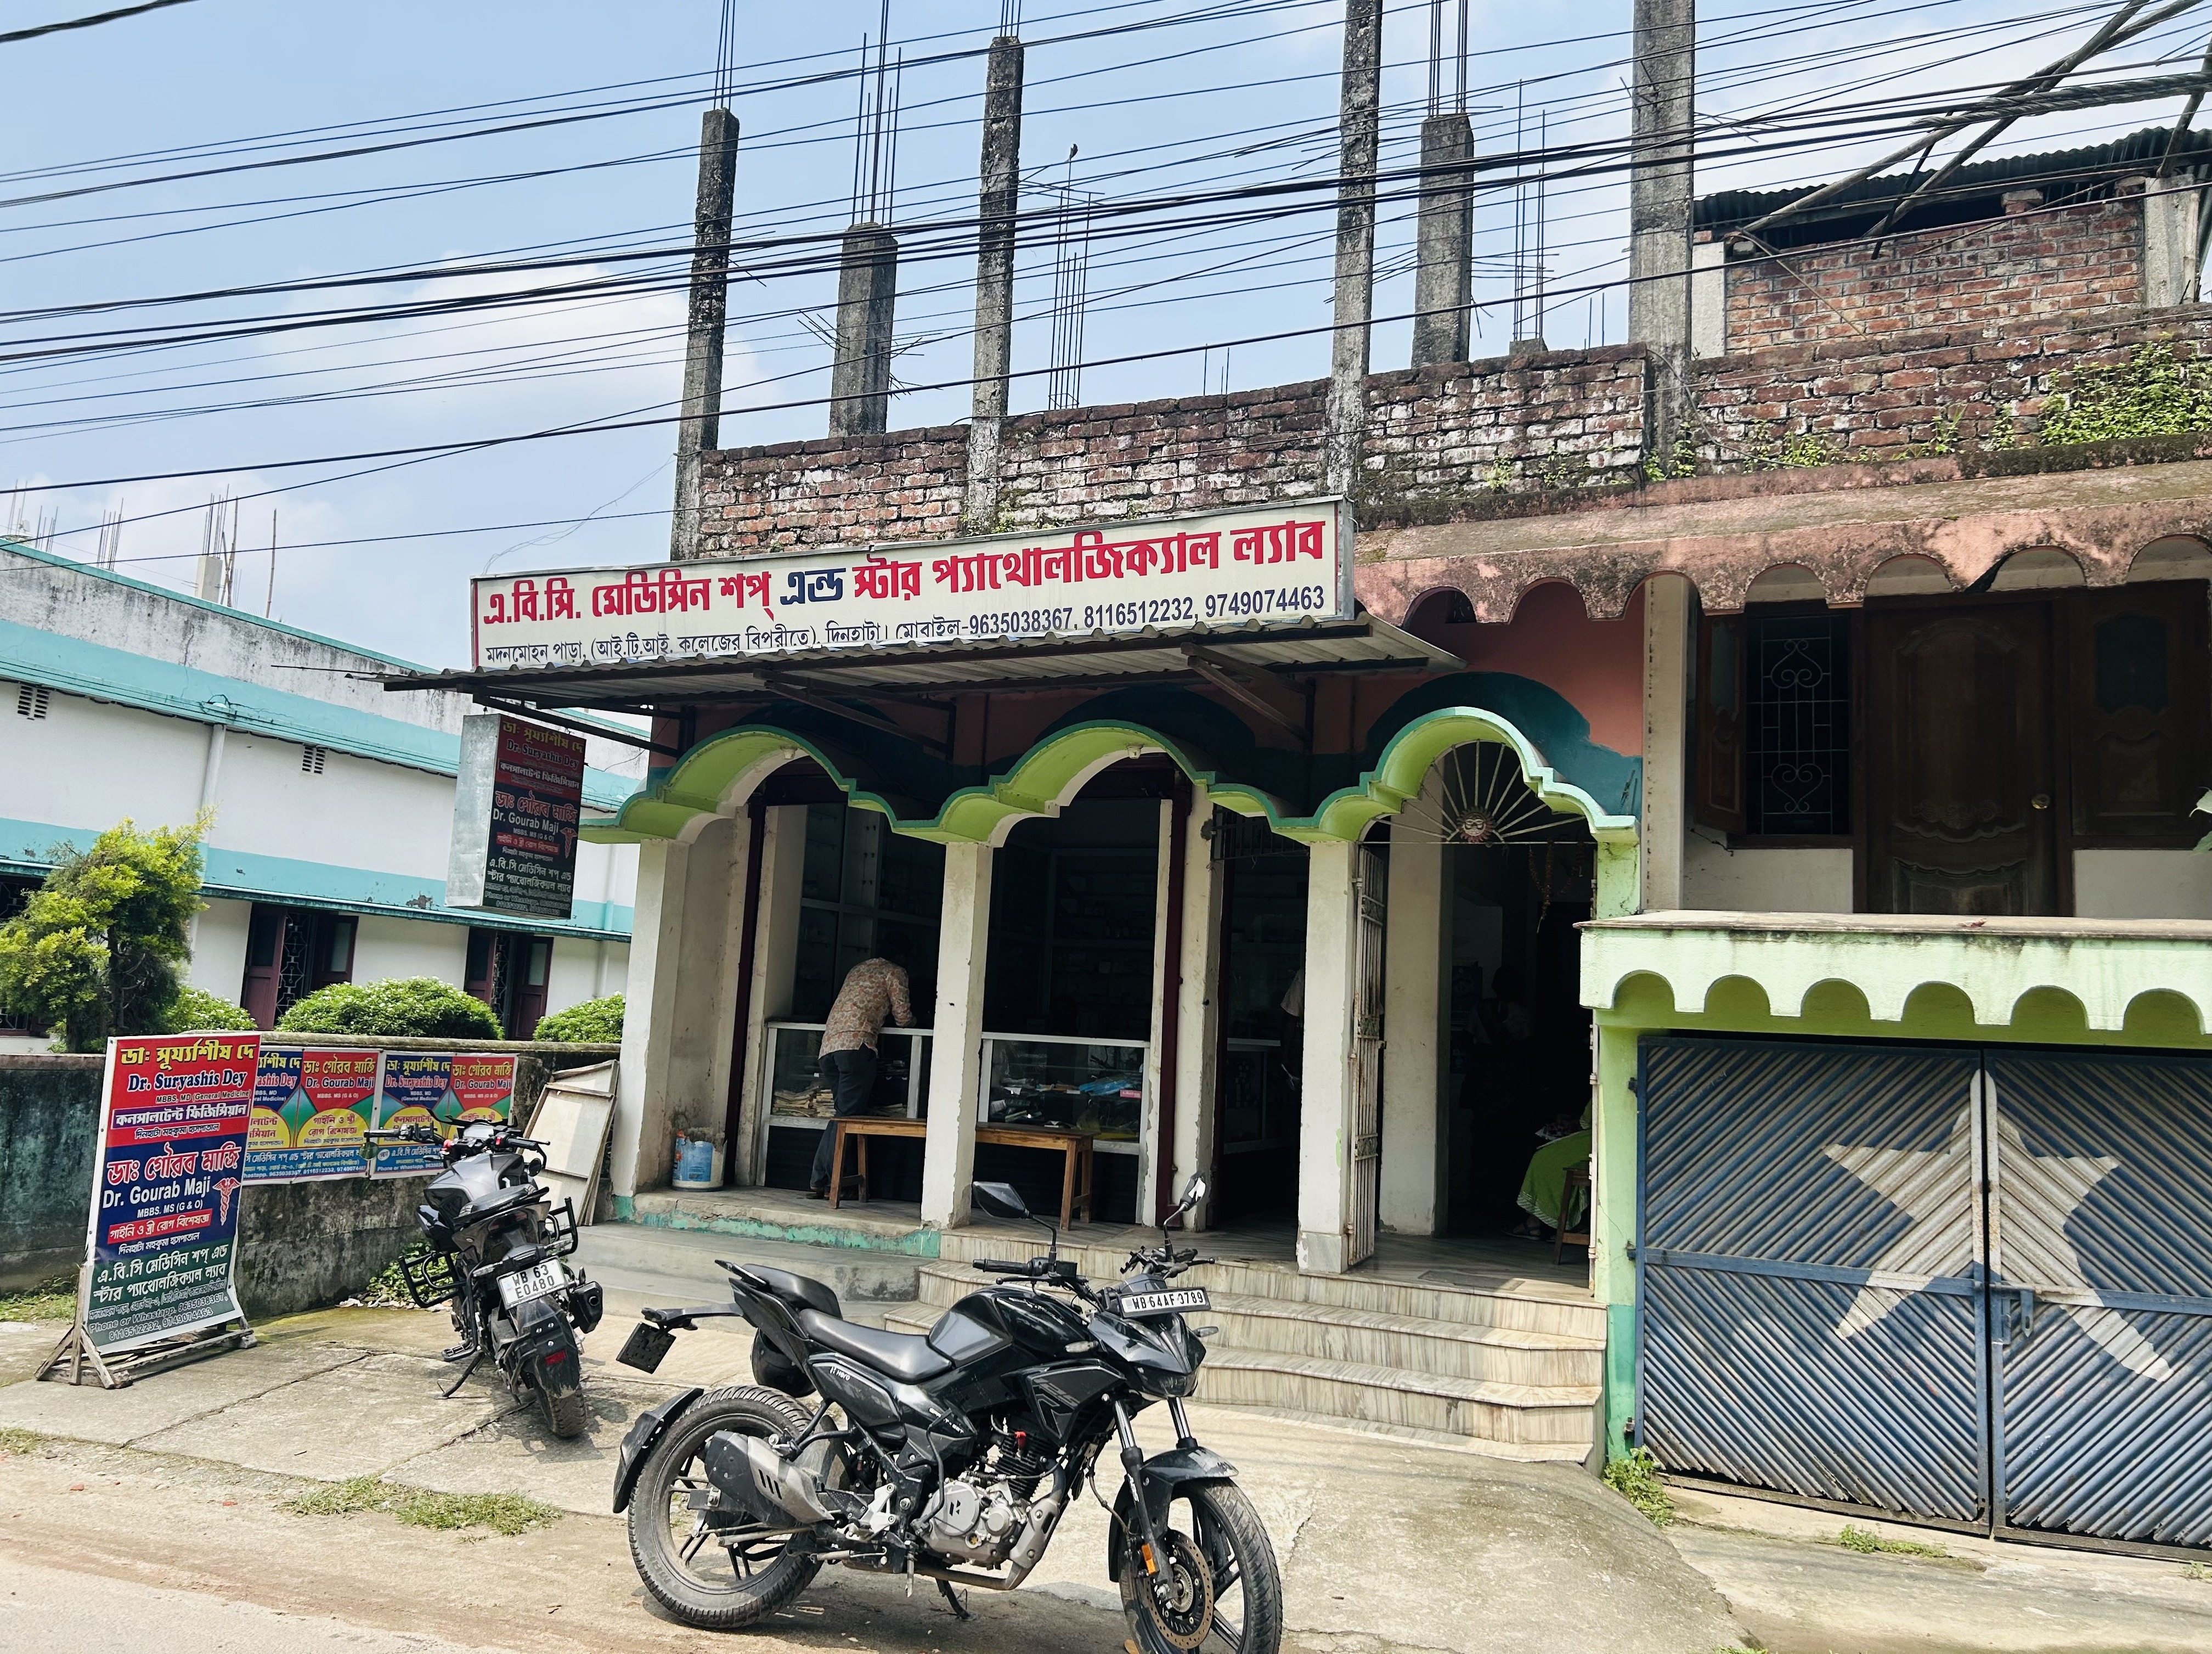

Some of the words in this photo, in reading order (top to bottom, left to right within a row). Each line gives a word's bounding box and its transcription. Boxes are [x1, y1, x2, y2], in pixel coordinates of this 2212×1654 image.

[592, 569, 712, 617] মেডিসিন
[932, 531, 1222, 593] প্যাথোলজিক্যাল
[1230, 520, 1325, 565] ল্যাব
[486, 644, 549, 663] মদনমোহন
[677, 633, 741, 653] কলেজের
[1084, 597, 1198, 628] 8116512232,
[1205, 585, 1324, 618] 9749074463
[507, 739, 521, 753] Dr.
[523, 744, 562, 763] Suryashis
[564, 755, 579, 770] Dey
[572, 742, 584, 753] দে
[517, 790, 551, 818] গৌরব
[493, 808, 506, 822] Dr.
[509, 812, 539, 829] Gourab
[542, 819, 559, 835] Maji
[237, 1044, 257, 1060] দে
[290, 1057, 302, 1069] দে
[323, 1054, 352, 1074] গৌরব
[441, 1062, 452, 1072] দে
[469, 1059, 493, 1077] গৌরব
[127, 1074, 151, 1092] Dr.
[155, 1071, 219, 1091] Suryashis
[223, 1070, 248, 1087] Dey
[280, 1073, 298, 1090] Dey
[306, 1077, 320, 1088] Dr.
[322, 1077, 355, 1088] Gourab
[357, 1076, 376, 1090] Maji
[385, 1075, 397, 1088] Dr.
[399, 1075, 433, 1090] Suryashis
[434, 1076, 448, 1090] Dey
[454, 1079, 466, 1089] Dr.
[468, 1079, 495, 1089] Gourab
[496, 1078, 511, 1090] Maji
[193, 1092, 219, 1101] (General
[221, 1089, 252, 1098] Medicine)
[116, 1108, 184, 1126] কনসালটেন্ট
[186, 1103, 247, 1120] ফিজিসিয়ান
[308, 1128, 325, 1138] রোগ
[144, 1141, 199, 1181] গৌরব
[103, 1190, 124, 1208] Dr.
[129, 1180, 180, 1205] Gourab
[184, 1176, 211, 1197] Maji
[163, 1203, 174, 1213] MS
[176, 1202, 185, 1212] (G
[194, 1200, 204, 1209] O)
[137, 1225, 144, 1235] ও
[157, 1219, 175, 1231] রোগ
[98, 1259, 143, 1283] এ.বি.সি
[145, 1250, 190, 1274] মেডিসিন
[512, 1271, 528, 1287] WB
[533, 1264, 549, 1278] 63
[127, 1268, 203, 1296] প্যাথোলজিক্যাল
[205, 1263, 228, 1278] ল্যাব
[515, 1275, 555, 1299] E0480
[89, 1319, 118, 1334] Phone
[120, 1317, 132, 1326] or
